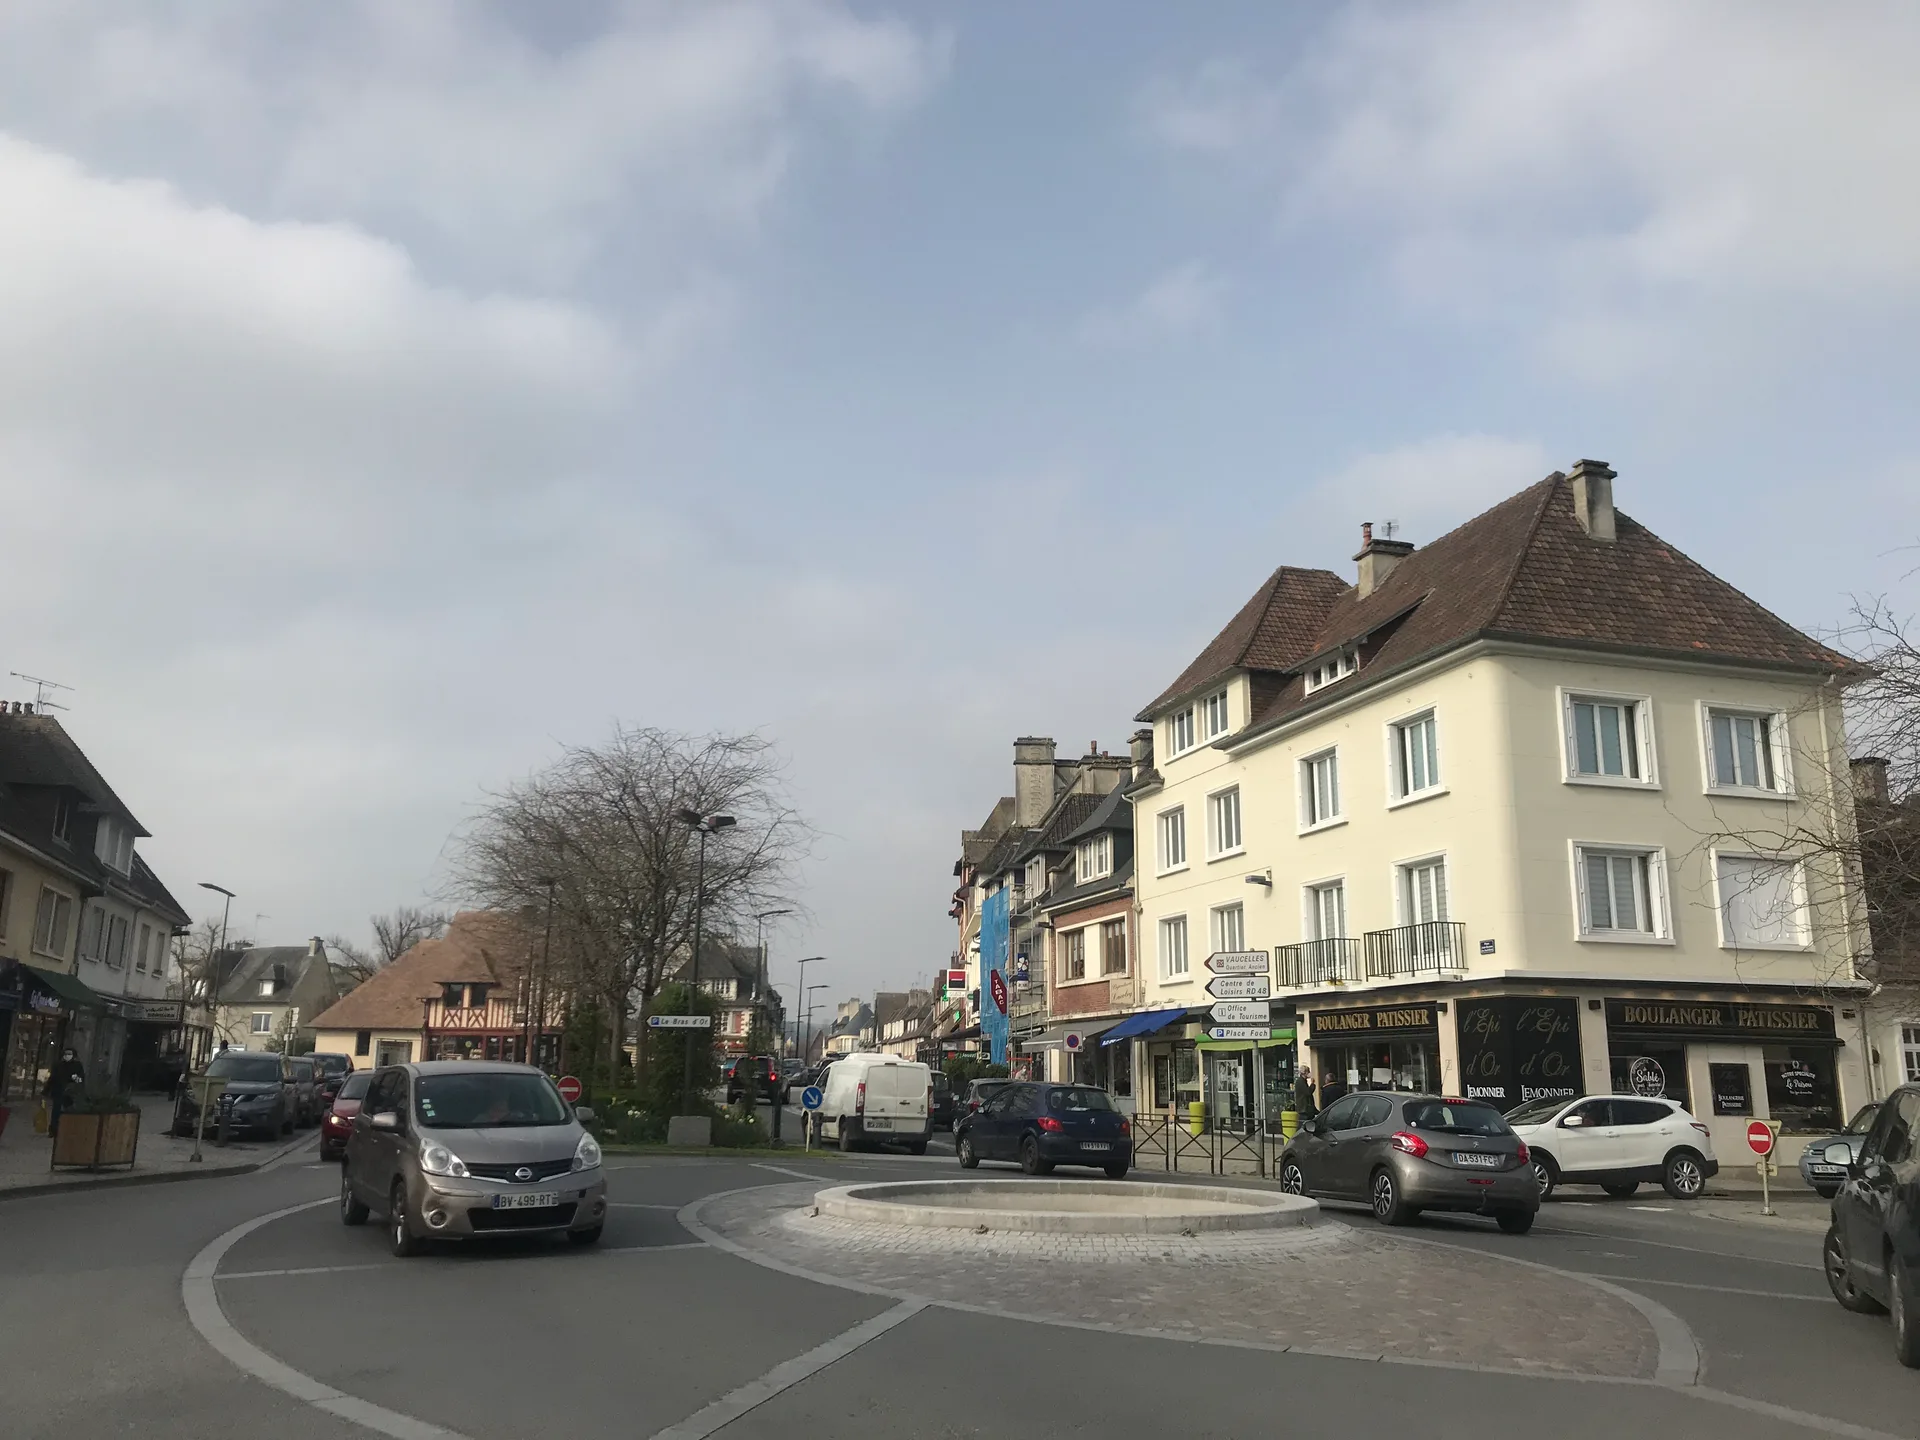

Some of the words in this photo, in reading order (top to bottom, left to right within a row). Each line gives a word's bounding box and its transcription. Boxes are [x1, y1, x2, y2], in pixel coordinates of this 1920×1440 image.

[1226, 955, 1265, 963] VAUCELLES
[994, 979, 1005, 1005] TABAC
[1239, 1012, 1267, 1020] Tourisme
[1316, 1012, 1371, 1031] BOULANGER
[1376, 1009, 1430, 1027] PATISSIER
[1624, 1005, 1723, 1026] BOULANGER
[1738, 1010, 1819, 1029] PATISSIER
[1250, 1029, 1268, 1037] Foch
[1636, 1070, 1660, 1083] Sablé
[1467, 1084, 1506, 1098] LEMONNIER
[1521, 1085, 1574, 1101] LEMONNIER
[501, 1194, 551, 1207] BV-499-RT
